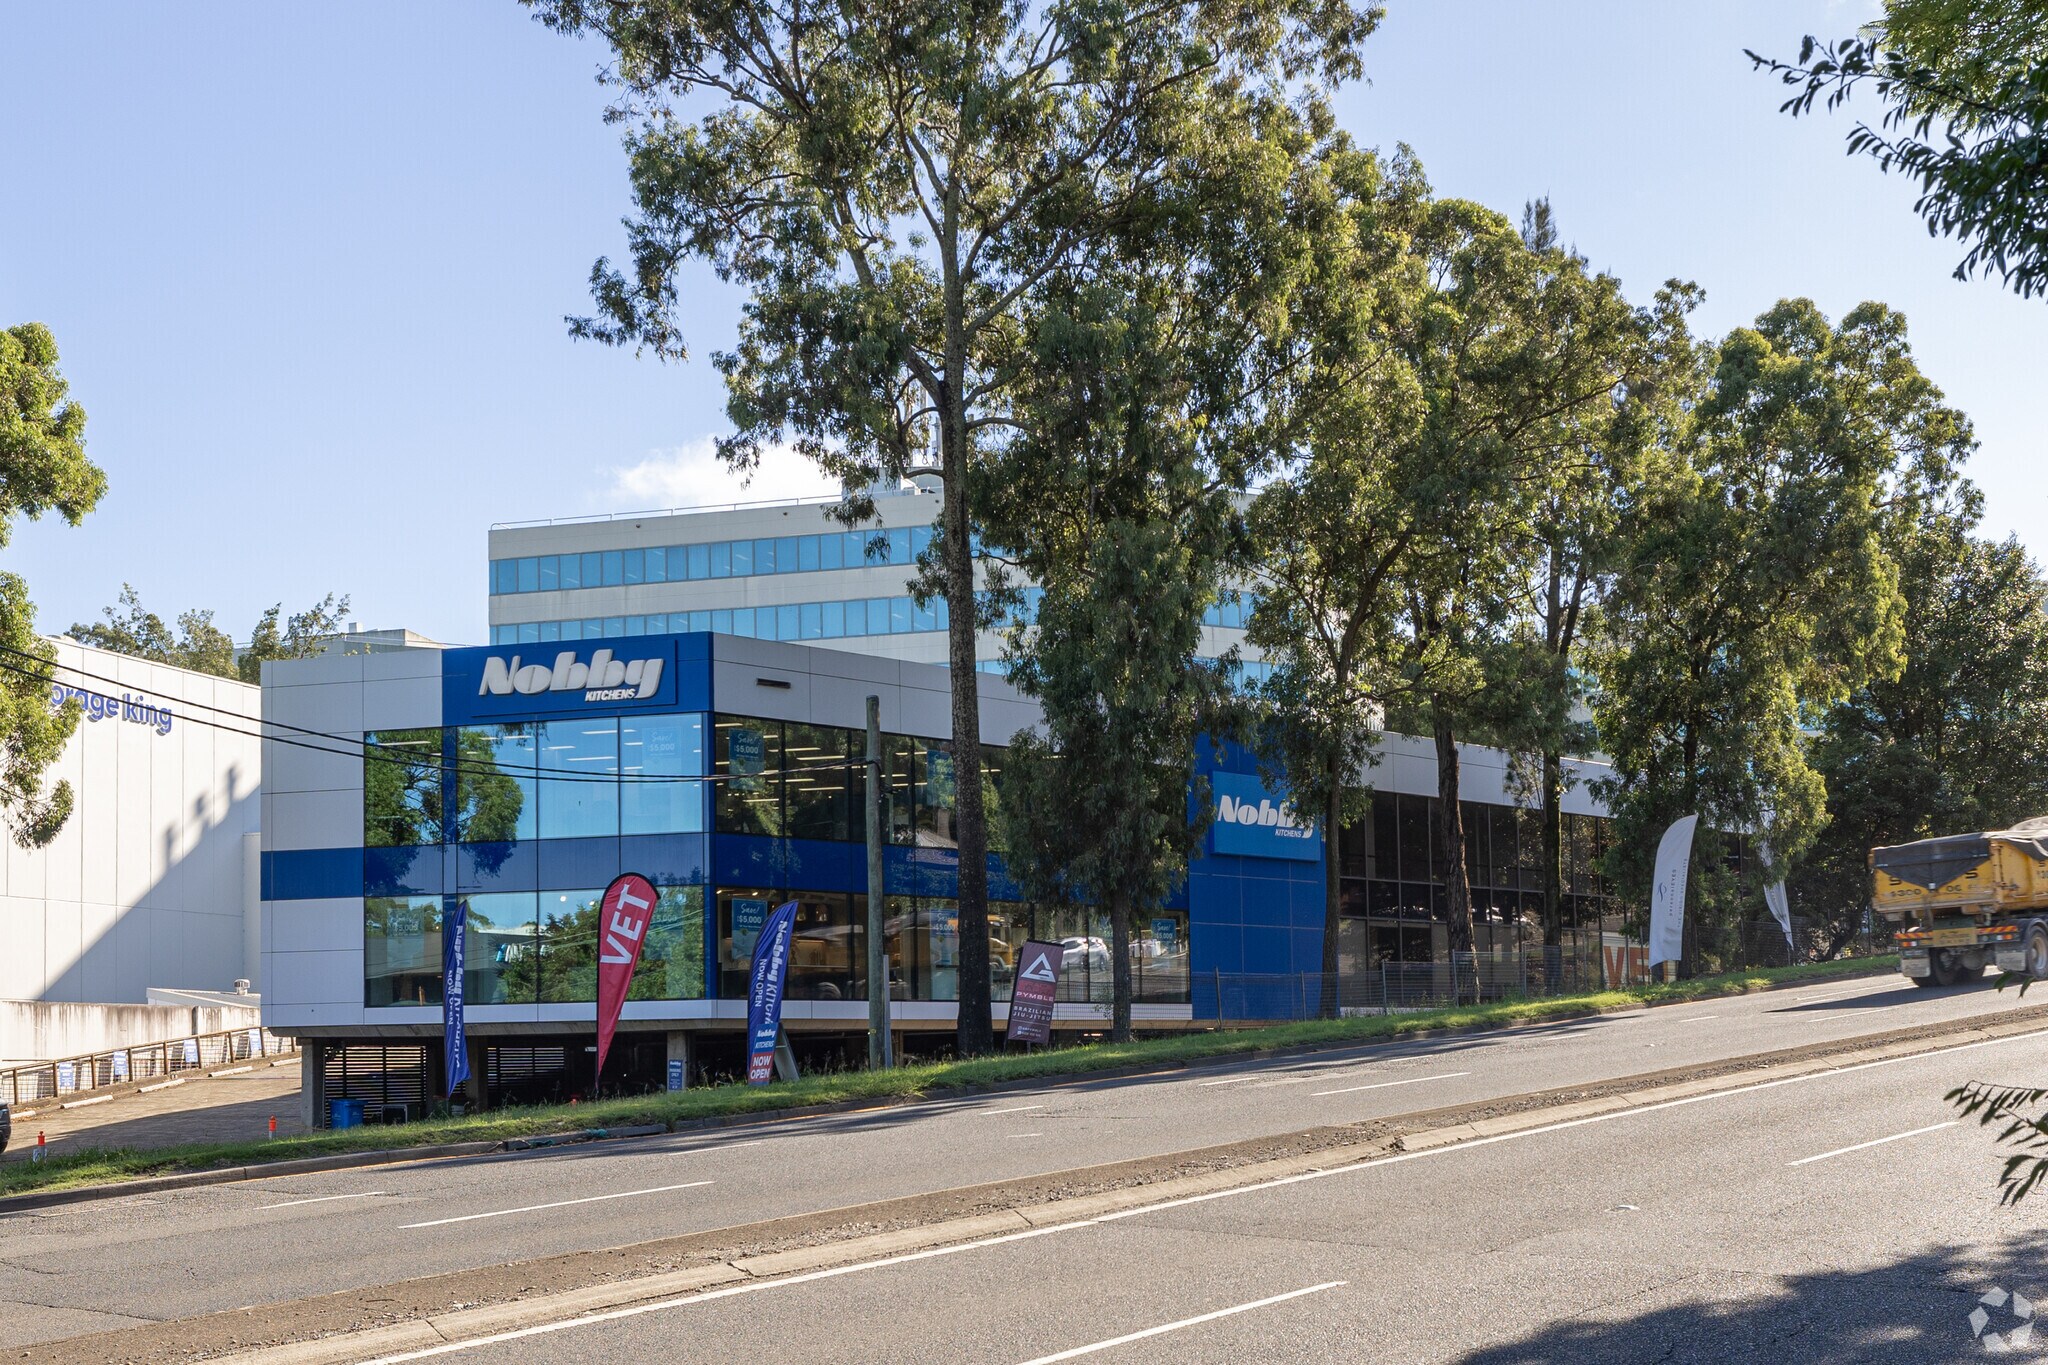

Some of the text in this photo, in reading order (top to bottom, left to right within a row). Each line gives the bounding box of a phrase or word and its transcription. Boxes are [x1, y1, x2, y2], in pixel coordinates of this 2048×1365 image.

[478, 649, 664, 699] Nobby
[584, 688, 636, 702] KITCHENS
[51, 685, 172, 734] orage king
[735, 744, 759, 755] $5,000
[1275, 828, 1302, 838] KITCHENS
[600, 884, 650, 964] VET
[738, 914, 762, 924] $5,000
[754, 958, 768, 1007] NOW OPEN
[1016, 991, 1054, 1002] PYMBLE
[1012, 1011, 1051, 1021] JIU-JITSU
[1013, 1005, 1052, 1016] BRAZILIAN
[753, 1055, 772, 1066] NOW
[751, 1068, 770, 1079] OPEN
